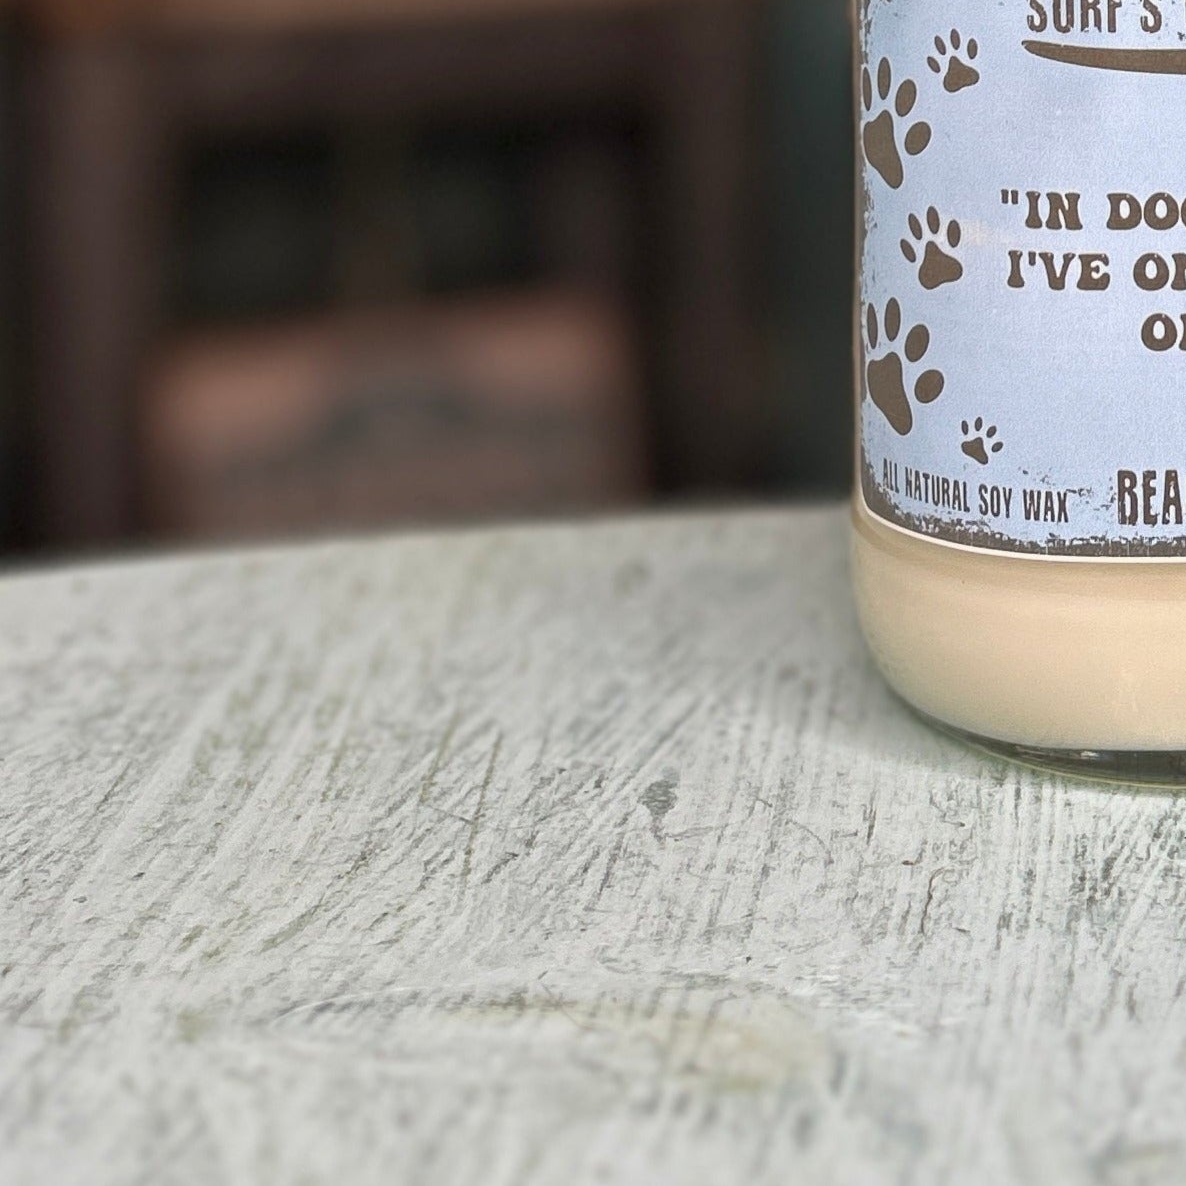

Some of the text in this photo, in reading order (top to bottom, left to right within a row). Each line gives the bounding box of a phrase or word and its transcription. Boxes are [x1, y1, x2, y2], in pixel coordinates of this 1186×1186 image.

[1000, 188, 1083, 231] "IN
[1006, 249, 1111, 291] I'VE
[882, 458, 1069, 523] ALL NATURAL SOY WAX
